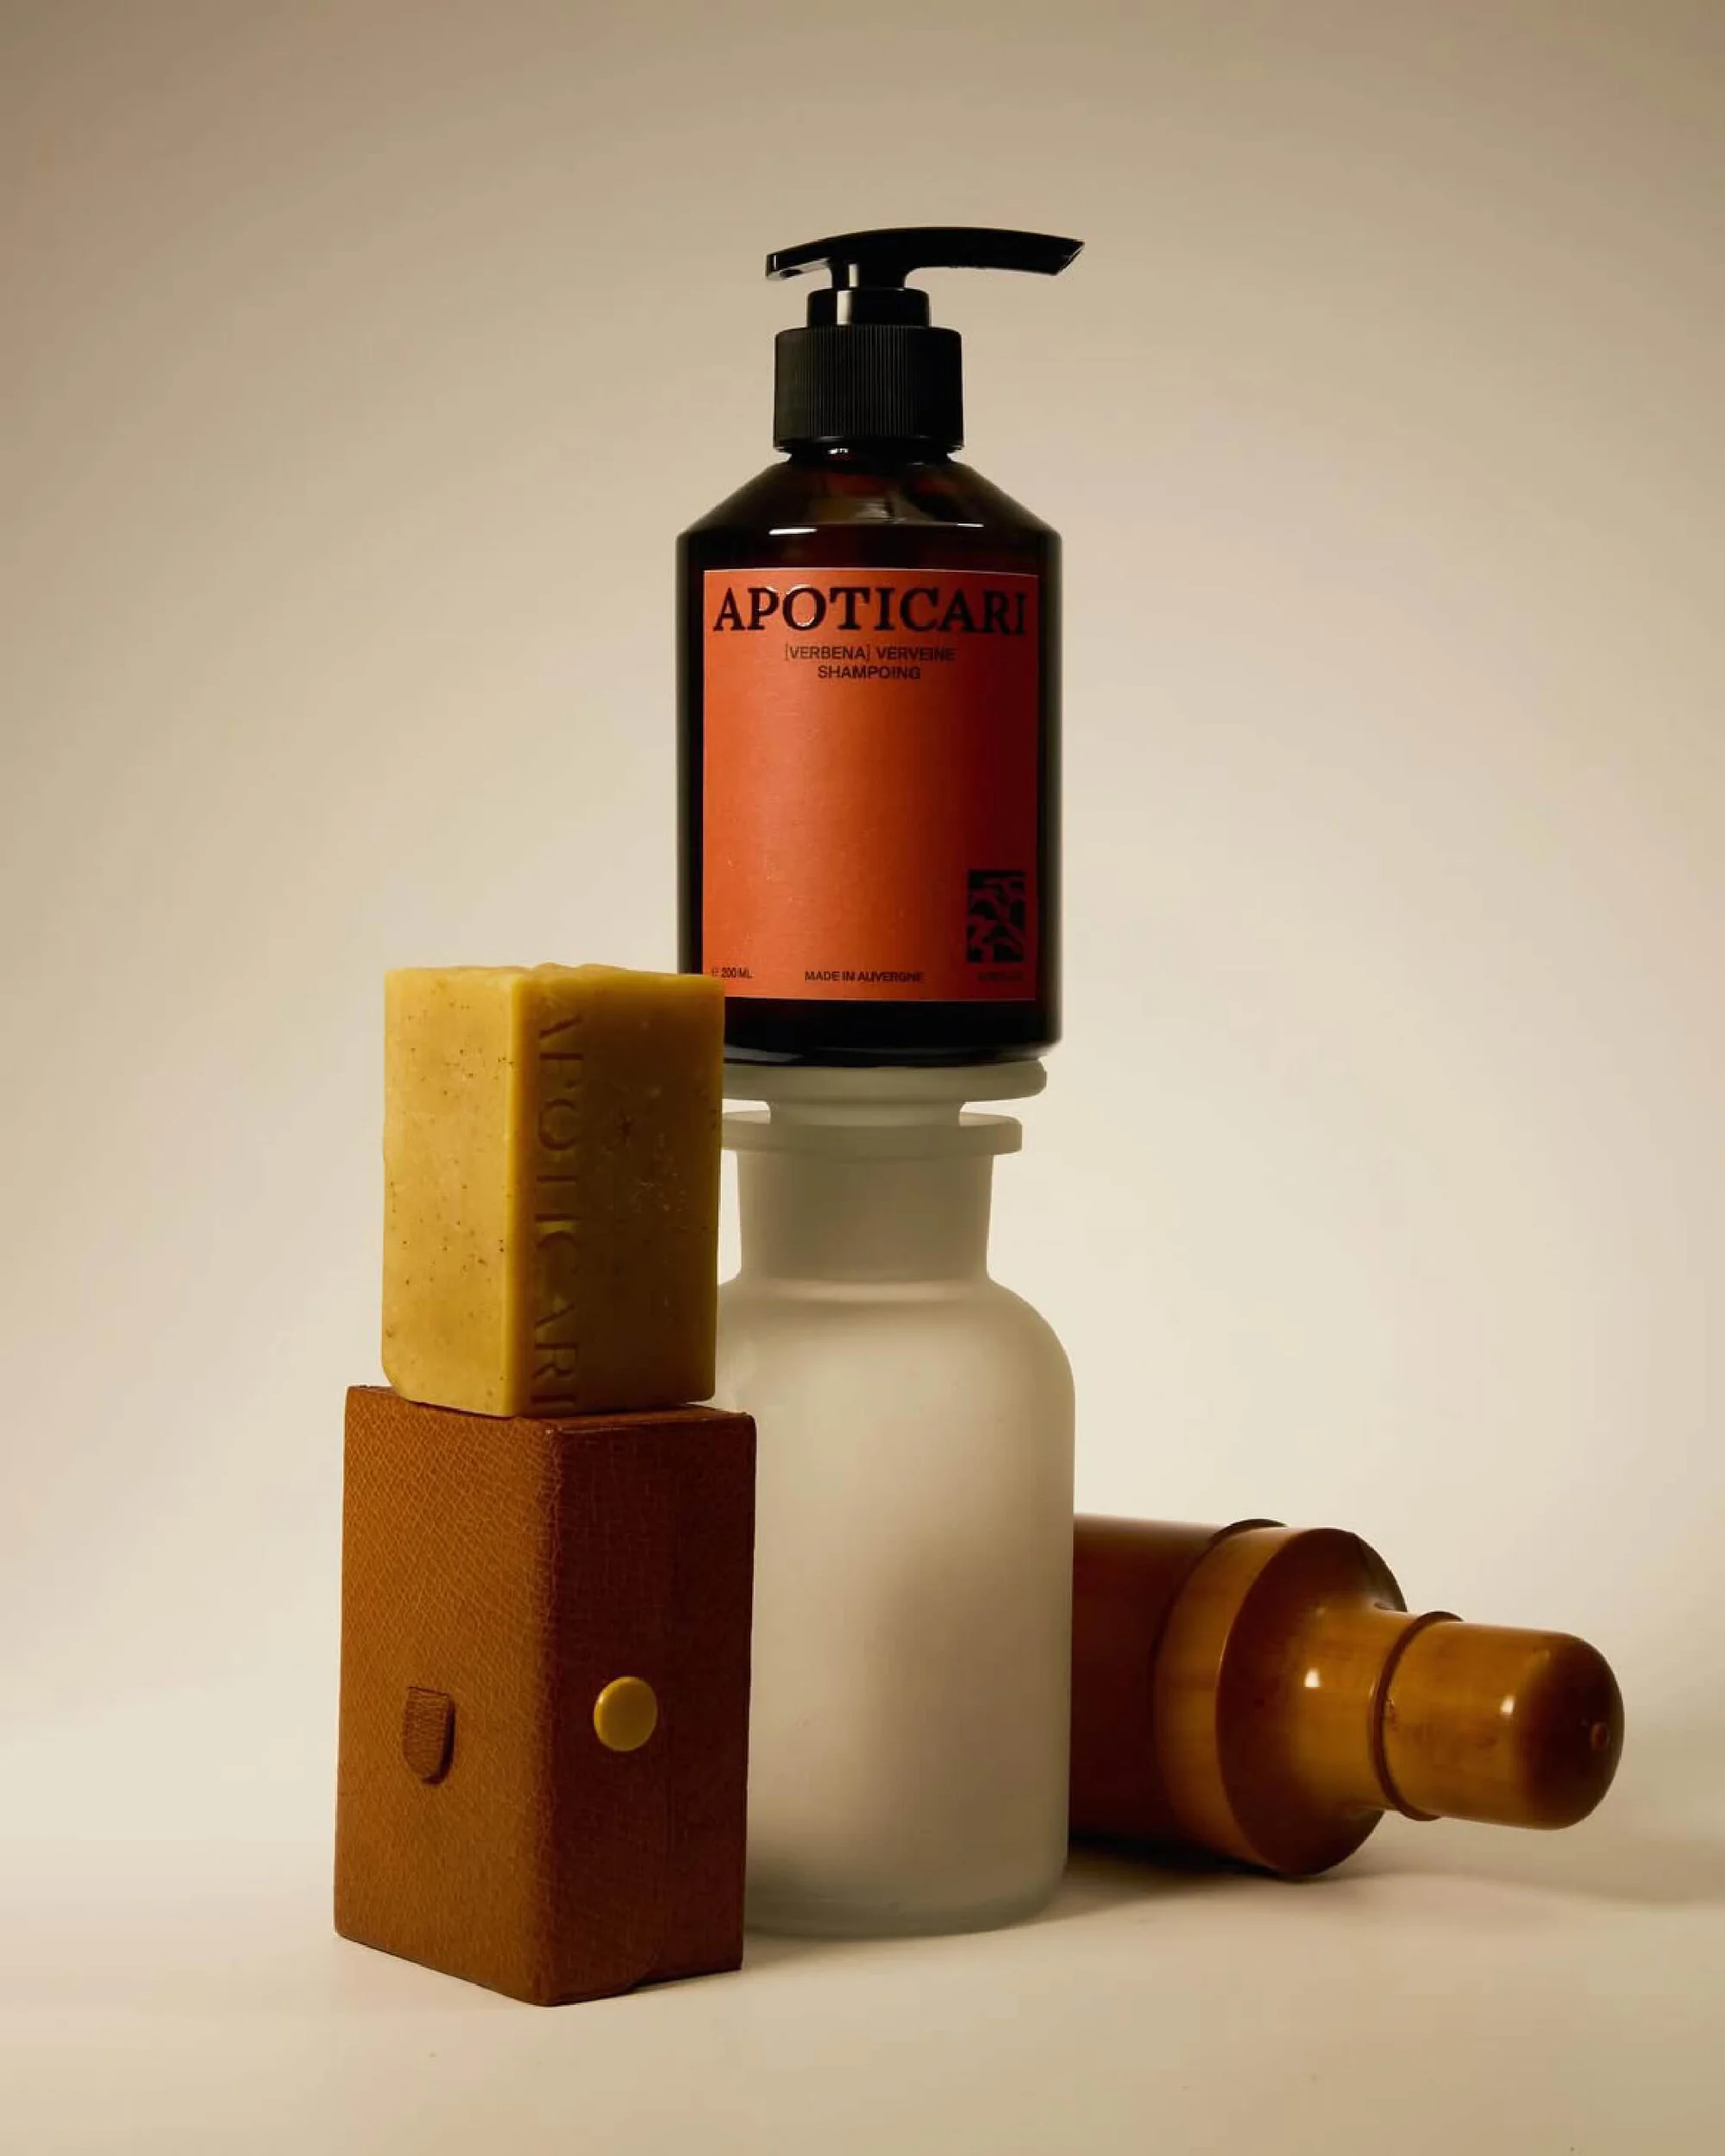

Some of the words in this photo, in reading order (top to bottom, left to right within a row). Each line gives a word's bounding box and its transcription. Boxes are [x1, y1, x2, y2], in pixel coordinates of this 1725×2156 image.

[713, 585, 1027, 635] APOTICARI
[785, 644, 871, 662] [VERBENA]
[875, 646, 956, 662] VERVEINE
[818, 665, 921, 680] SHAMPOING
[738, 967, 753, 980] ML
[804, 971, 840, 981] MADE
[842, 971, 855, 981] IN
[858, 971, 923, 982] AUVERGNE
